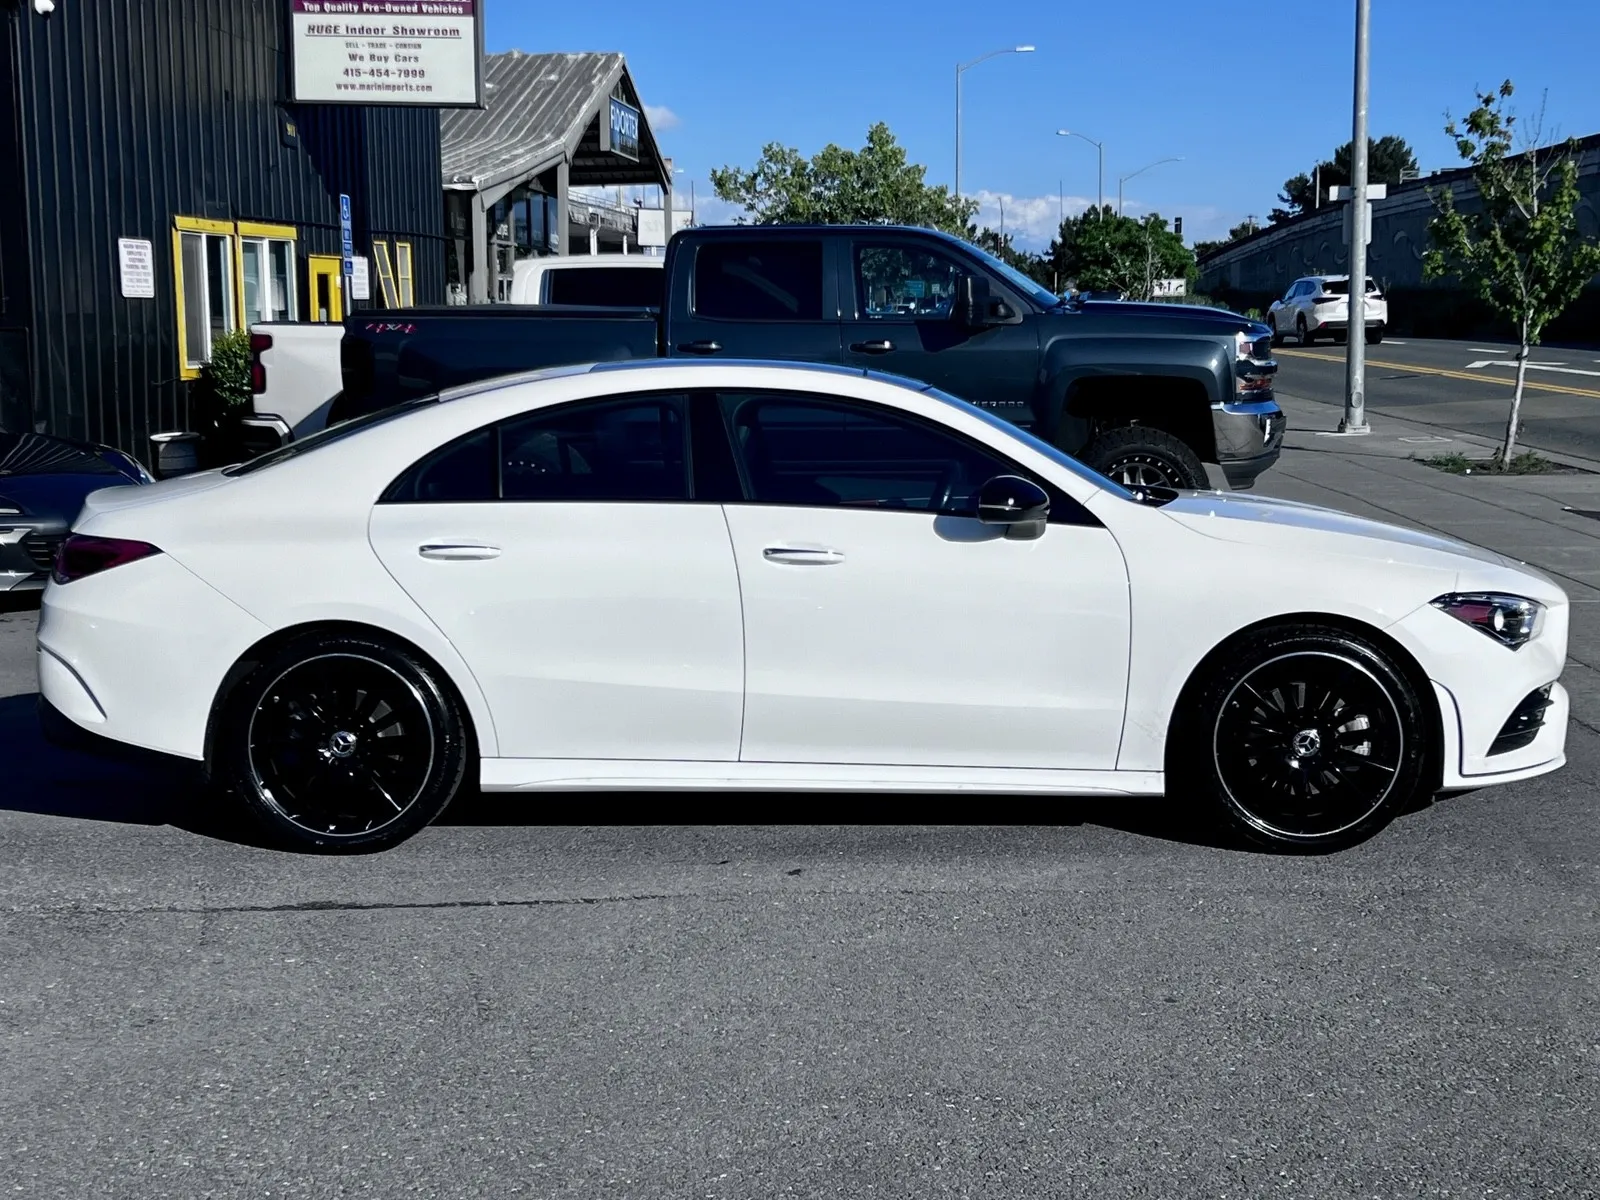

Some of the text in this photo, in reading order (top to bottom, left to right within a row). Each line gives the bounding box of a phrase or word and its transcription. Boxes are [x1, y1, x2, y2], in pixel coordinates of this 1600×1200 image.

[303, 3, 464, 14] Top Quality Pre-Owned Vehicles
[307, 24, 460, 36] HUGE Indoor Showroom
[348, 53, 420, 63] We Buy Cars
[343, 68, 425, 78] 415-454-7999
[336, 82, 433, 92] www.marinimports.com
